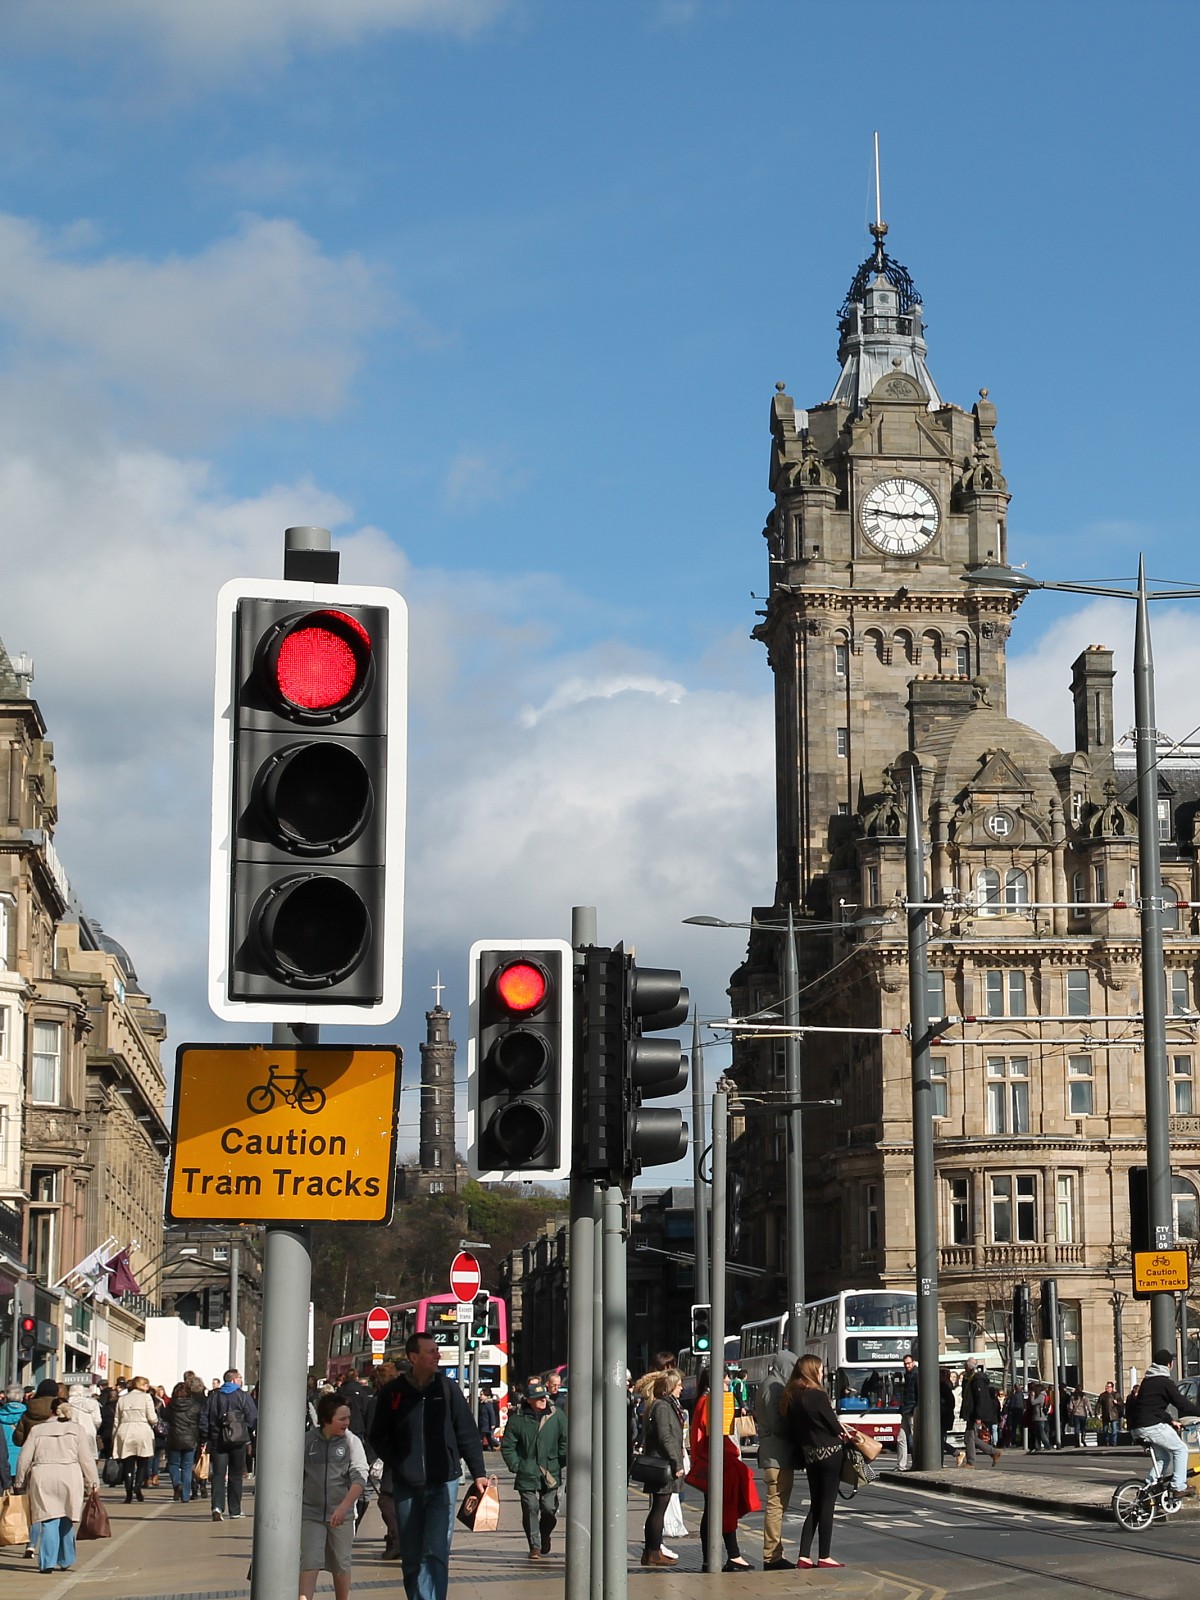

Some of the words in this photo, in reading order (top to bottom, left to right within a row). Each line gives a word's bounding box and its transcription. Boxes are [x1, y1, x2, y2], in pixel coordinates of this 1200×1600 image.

[220, 1127, 346, 1156] Caution
[181, 1167, 262, 1196] Tram
[272, 1168, 381, 1197] Tracks
[1146, 1268, 1177, 1276] Caution
[1160, 1278, 1186, 1286] Tracks
[434, 1333, 447, 1343] 22
[896, 1339, 911, 1350] 25
[64, 1375, 91, 1383] HOTEL
